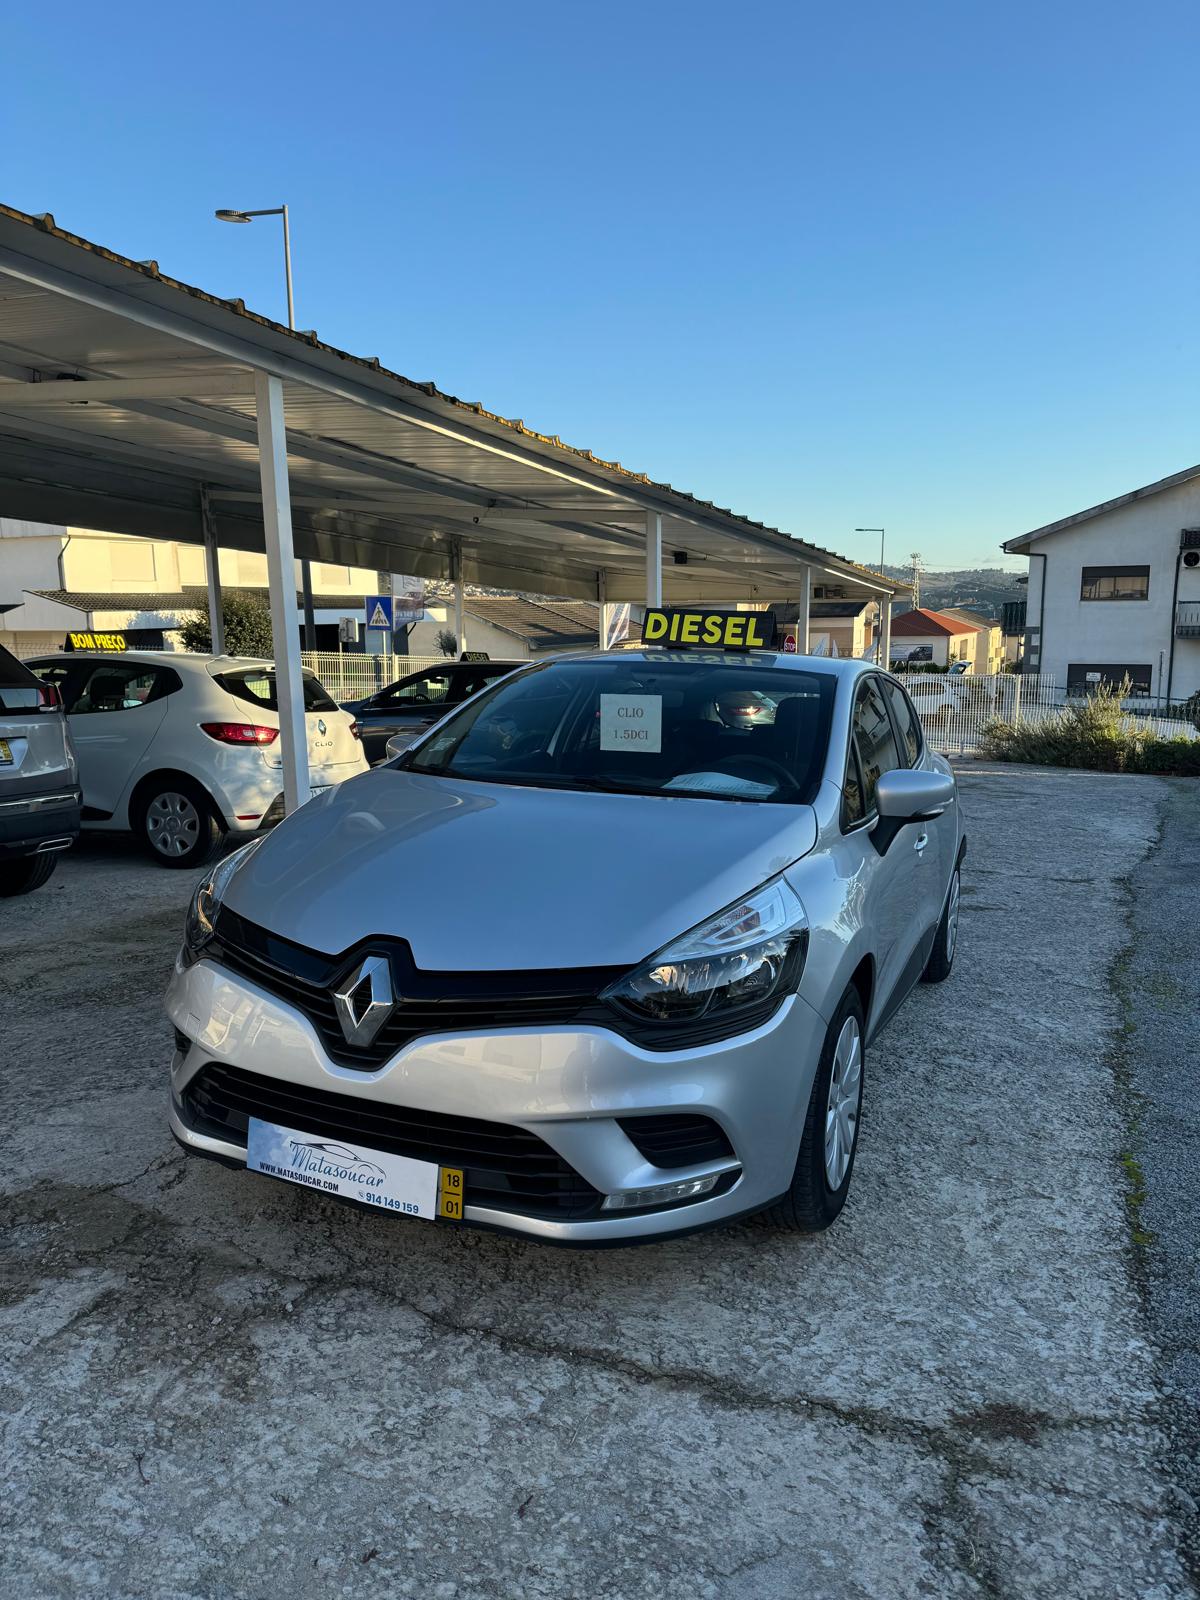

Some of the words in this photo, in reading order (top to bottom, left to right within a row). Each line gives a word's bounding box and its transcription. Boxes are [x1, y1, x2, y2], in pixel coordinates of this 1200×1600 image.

[645, 612, 764, 647] DIESEL
[70, 633, 96, 649] BOM
[94, 634, 126, 652] PREÇO
[784, 642, 796, 651] STOP
[617, 707, 644, 718] CLIO
[613, 729, 648, 740] 1.5DCI
[290, 1143, 384, 1188] Matasoucar
[259, 1161, 339, 1193] WWW.MATASOUCAR.COM
[446, 1173, 460, 1188] 18
[365, 1192, 382, 1205] 914
[383, 1196, 401, 1210] 149
[402, 1202, 419, 1214] 159
[445, 1200, 460, 1215] 01
